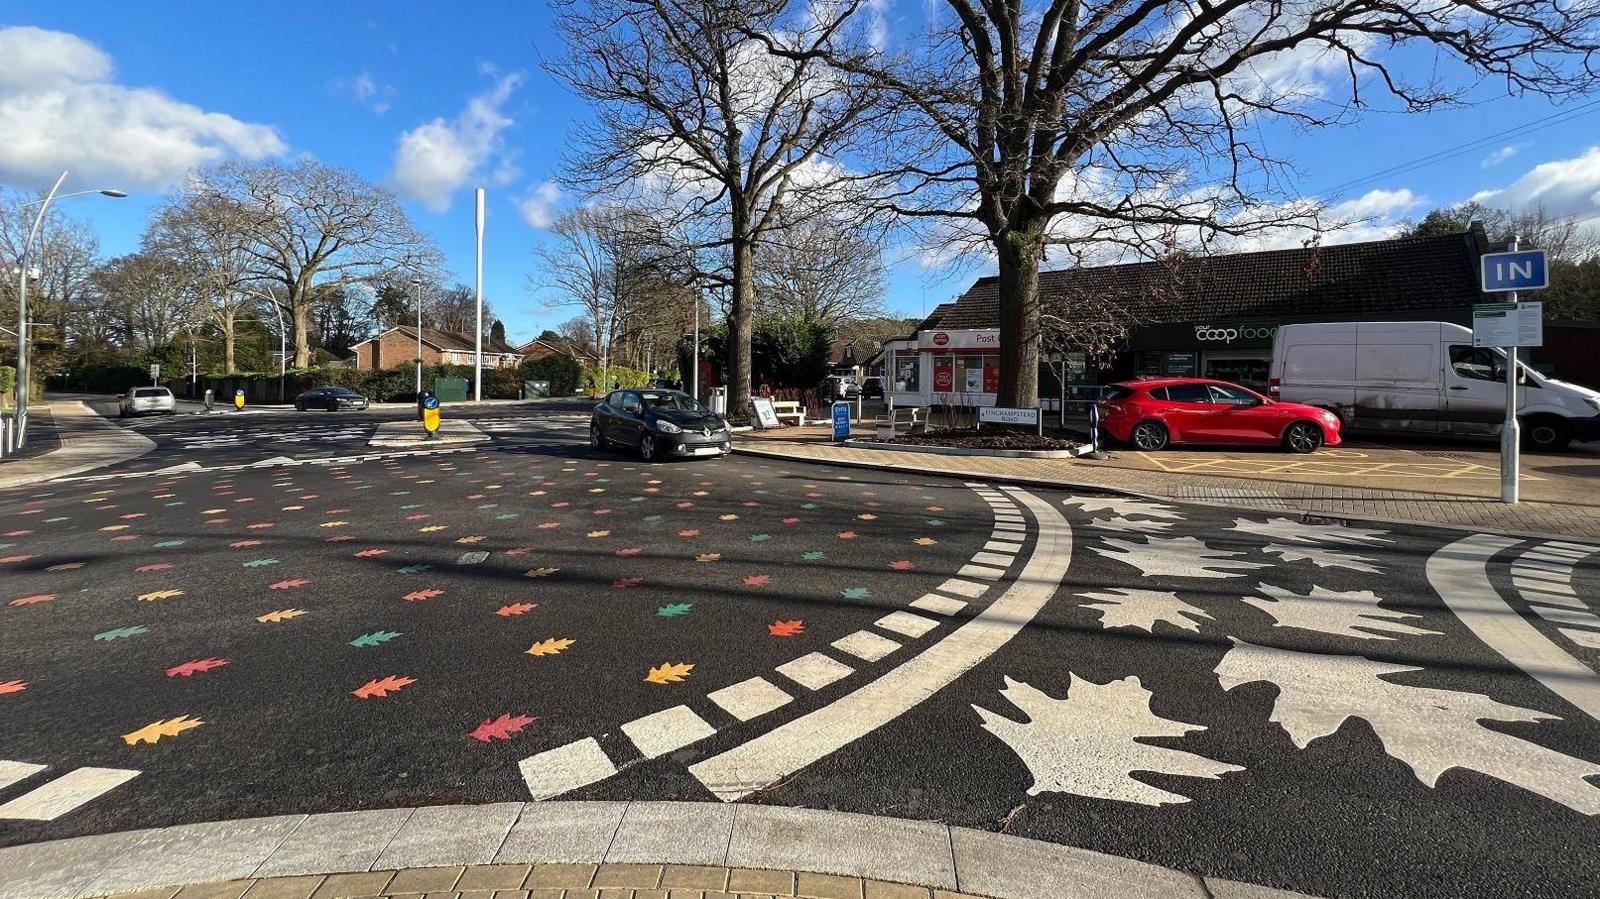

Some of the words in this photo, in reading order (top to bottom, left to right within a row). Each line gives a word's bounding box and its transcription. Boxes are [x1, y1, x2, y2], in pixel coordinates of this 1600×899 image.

[1497, 261, 1532, 281] IN
[976, 334, 995, 343] Post
[985, 409, 1035, 418] FINCHAMPSTEAD
